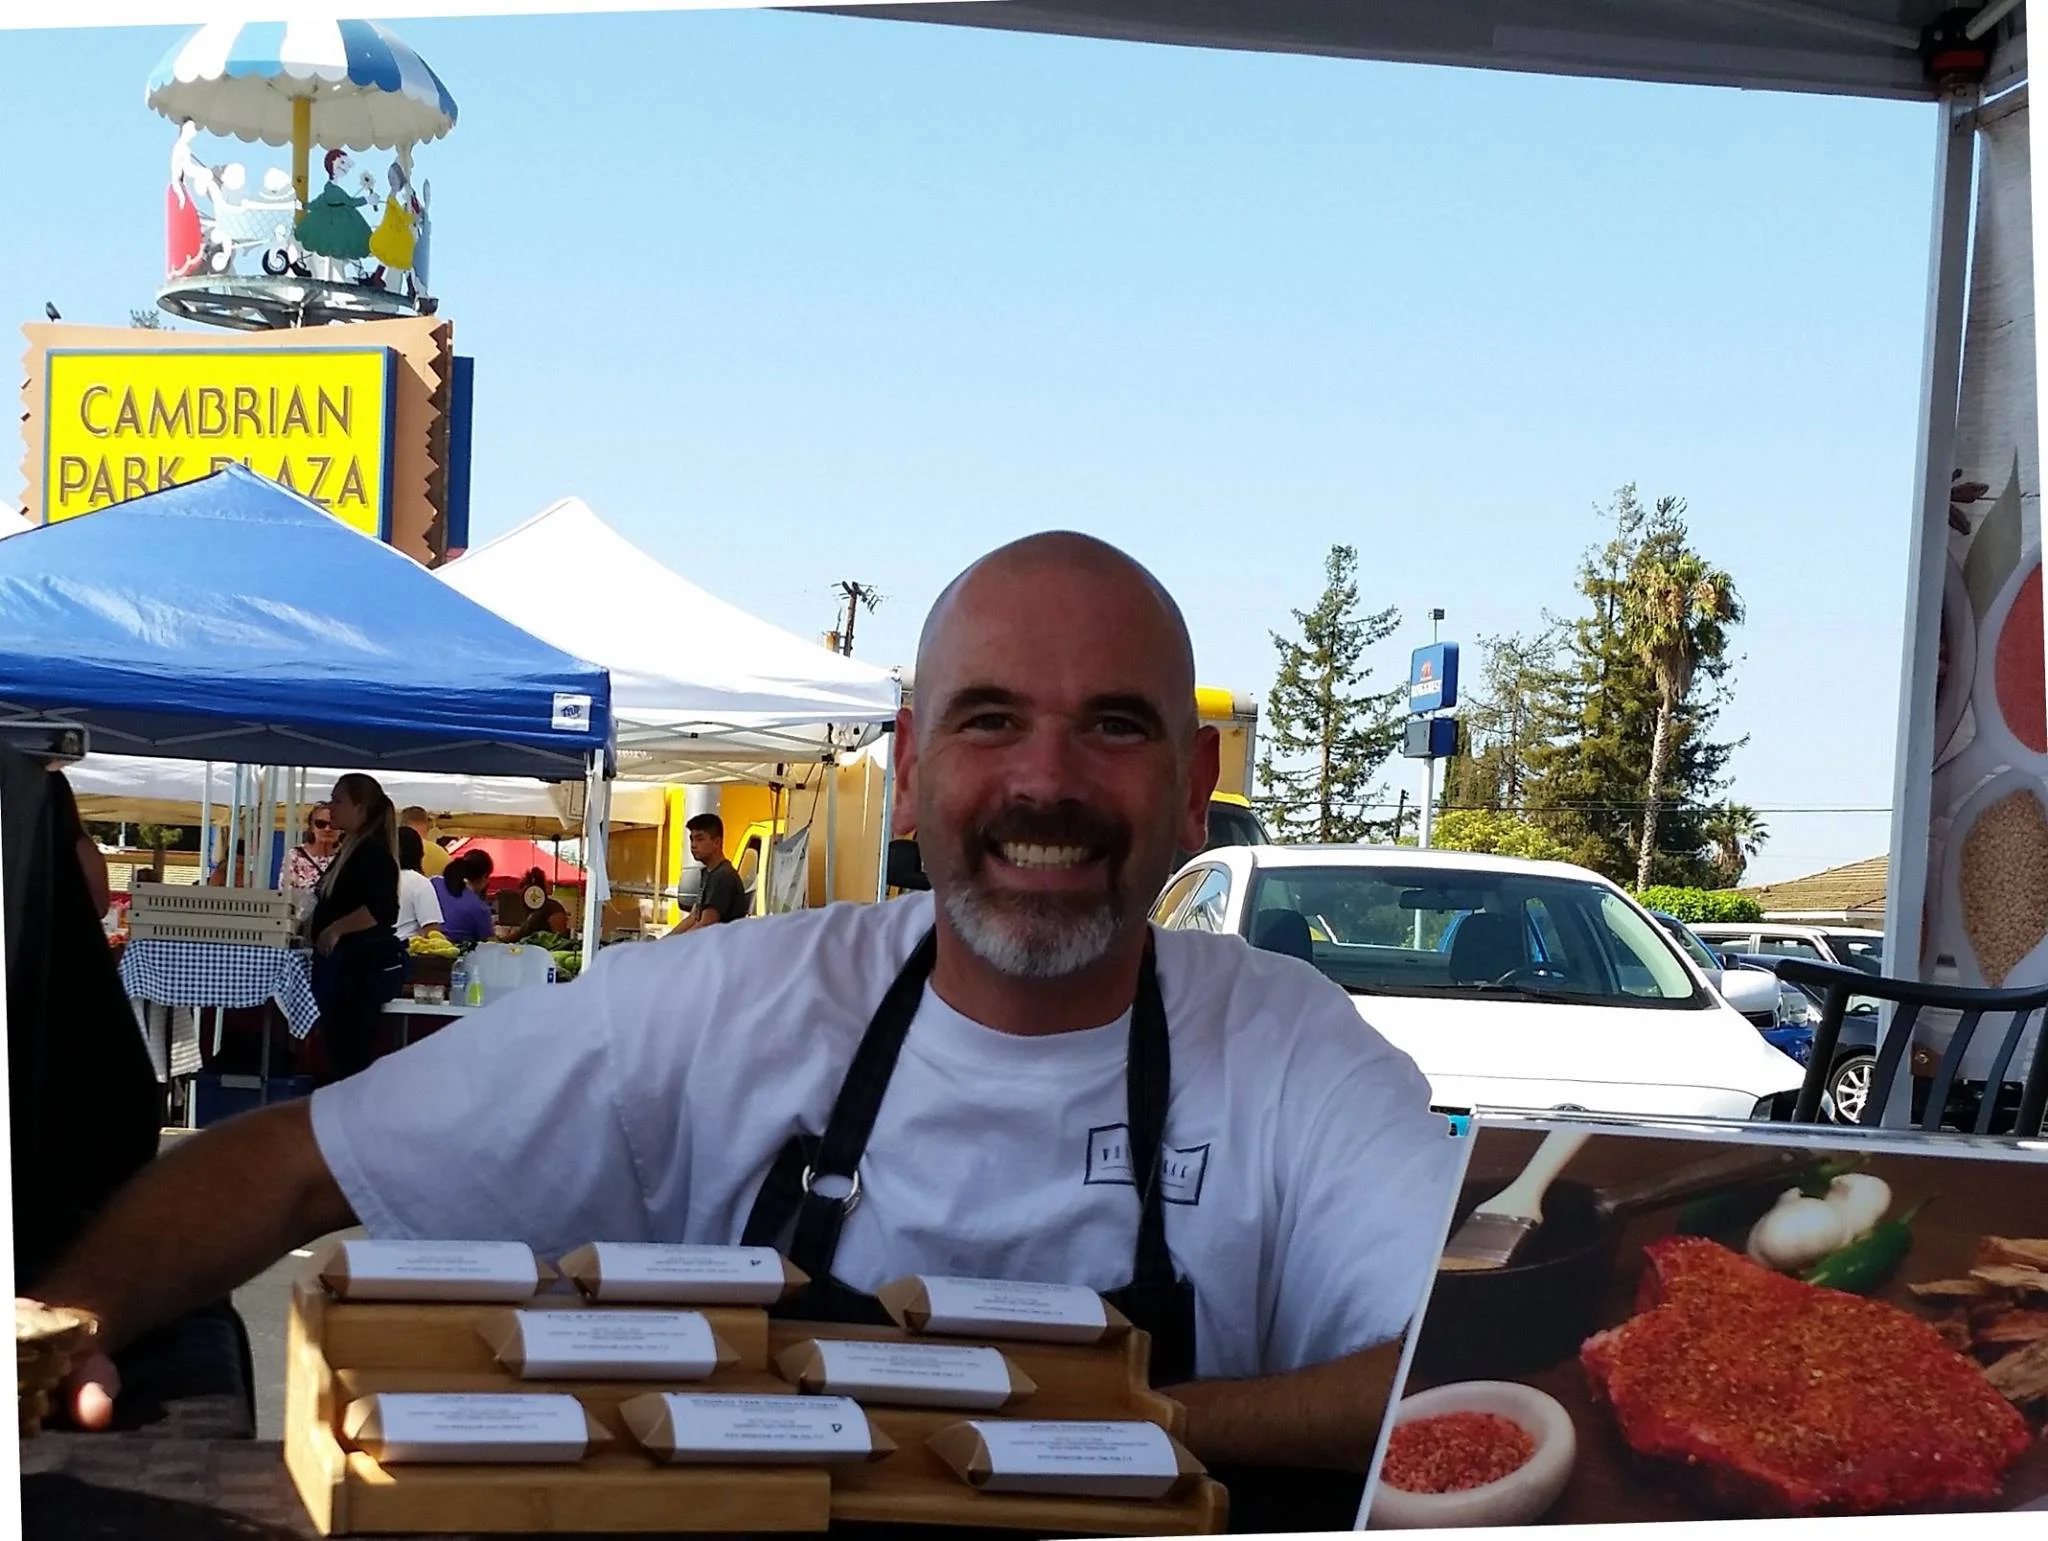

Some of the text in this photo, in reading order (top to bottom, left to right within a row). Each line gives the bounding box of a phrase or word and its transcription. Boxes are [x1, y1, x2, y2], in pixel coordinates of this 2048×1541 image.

[80, 385, 352, 437] CAMBRIAN
[59, 455, 368, 506] PARK AZA
